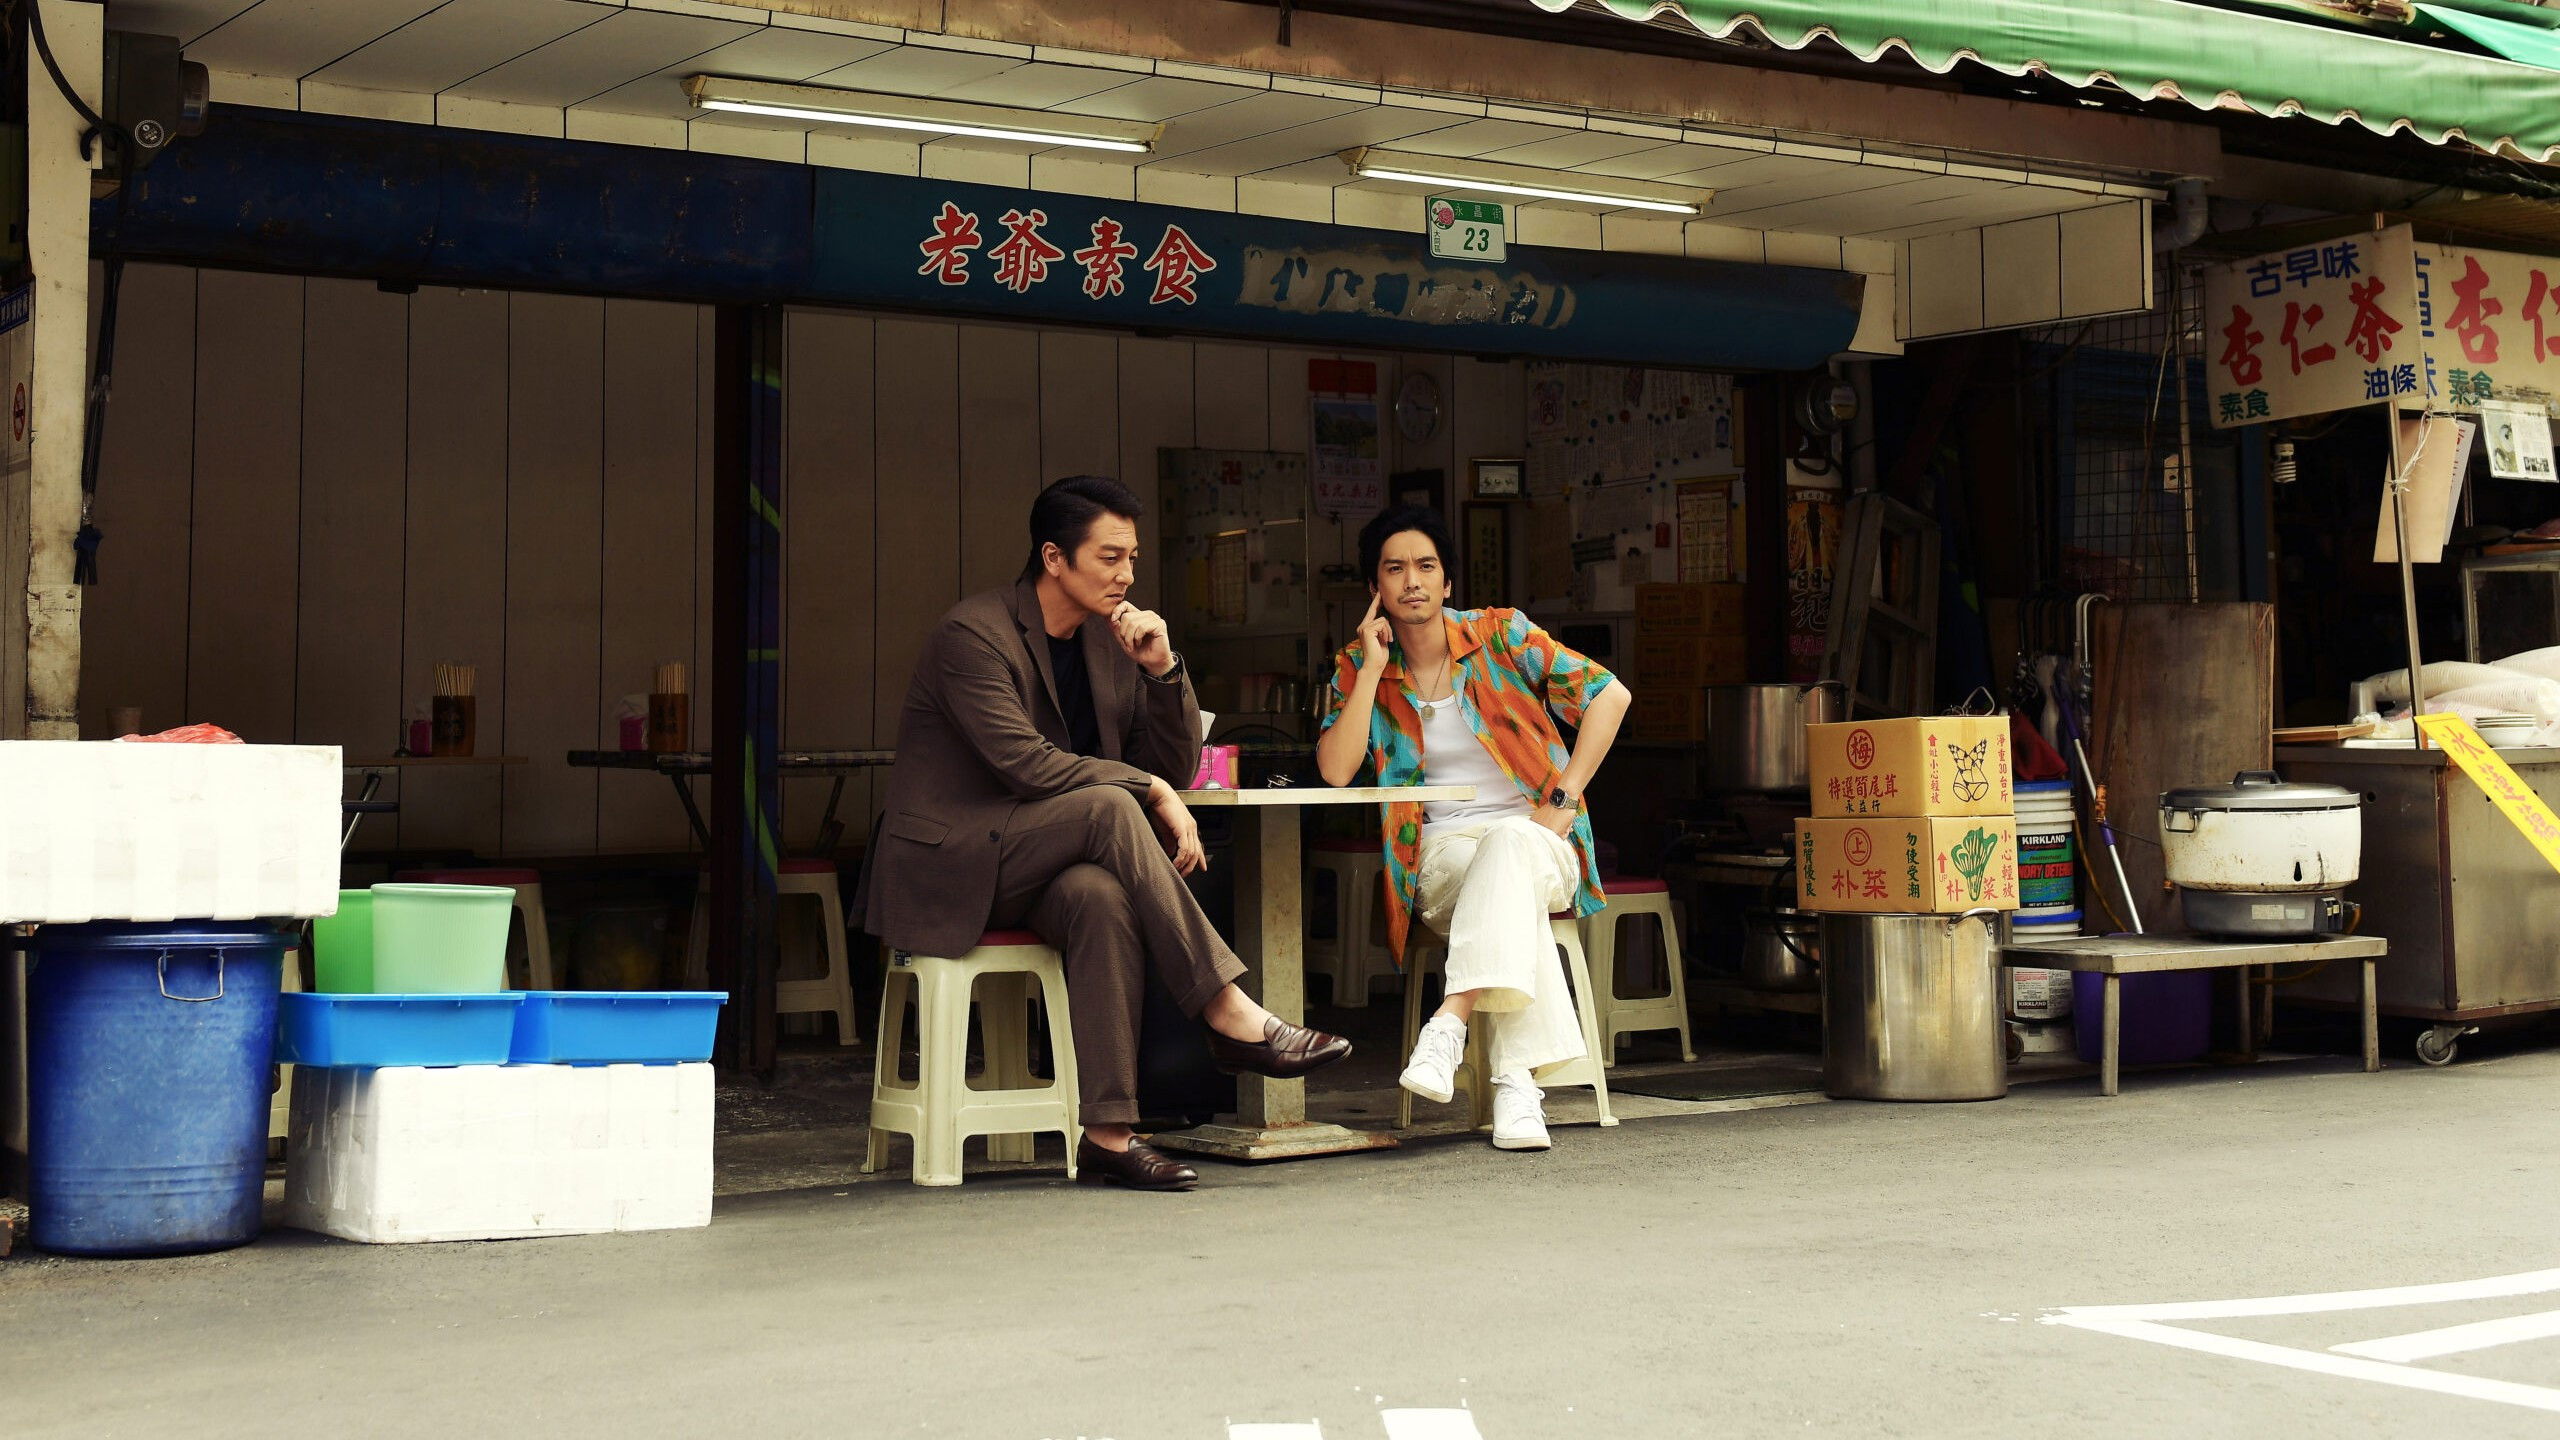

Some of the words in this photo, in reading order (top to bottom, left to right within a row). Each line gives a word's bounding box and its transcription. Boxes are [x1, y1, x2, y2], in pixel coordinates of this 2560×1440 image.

[918, 200, 1217, 305] 老爺素食
[1463, 227, 1490, 252] 23
[2247, 242, 2361, 300] 古早味
[2219, 276, 2403, 387] 杏仁茶
[2363, 364, 2418, 400] 油條
[2218, 388, 2272, 424] 素食
[1850, 735, 1872, 764] 梅
[1852, 836, 1867, 854] 上
[2021, 834, 2066, 846] KIRKLAND
[1802, 832, 1817, 897] 品質優良
[1905, 832, 1921, 899] 勿使受潮
[2001, 829, 2016, 899] 小心輕放
[1831, 869, 1889, 900] 朴菜
